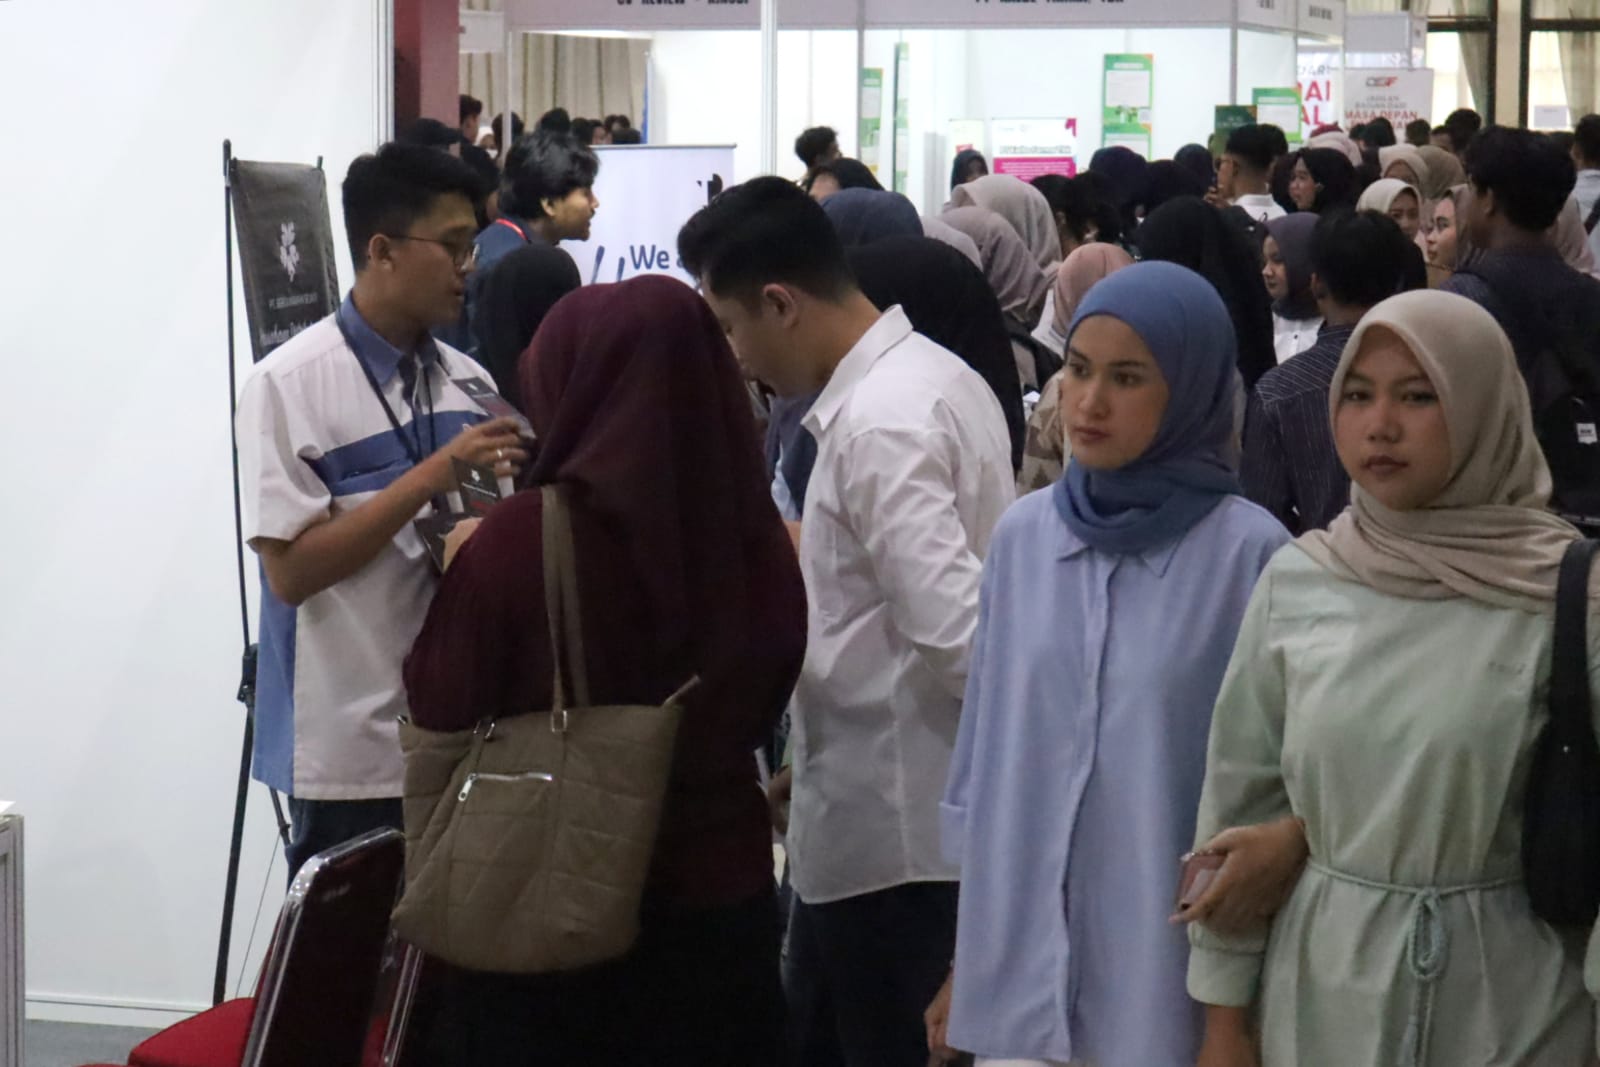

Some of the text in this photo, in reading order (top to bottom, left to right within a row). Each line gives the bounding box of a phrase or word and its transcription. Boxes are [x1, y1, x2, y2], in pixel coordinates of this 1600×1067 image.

[1297, 80, 1331, 102] AI
[1380, 111, 1418, 119] DEPAN
[631, 245, 669, 270] We
